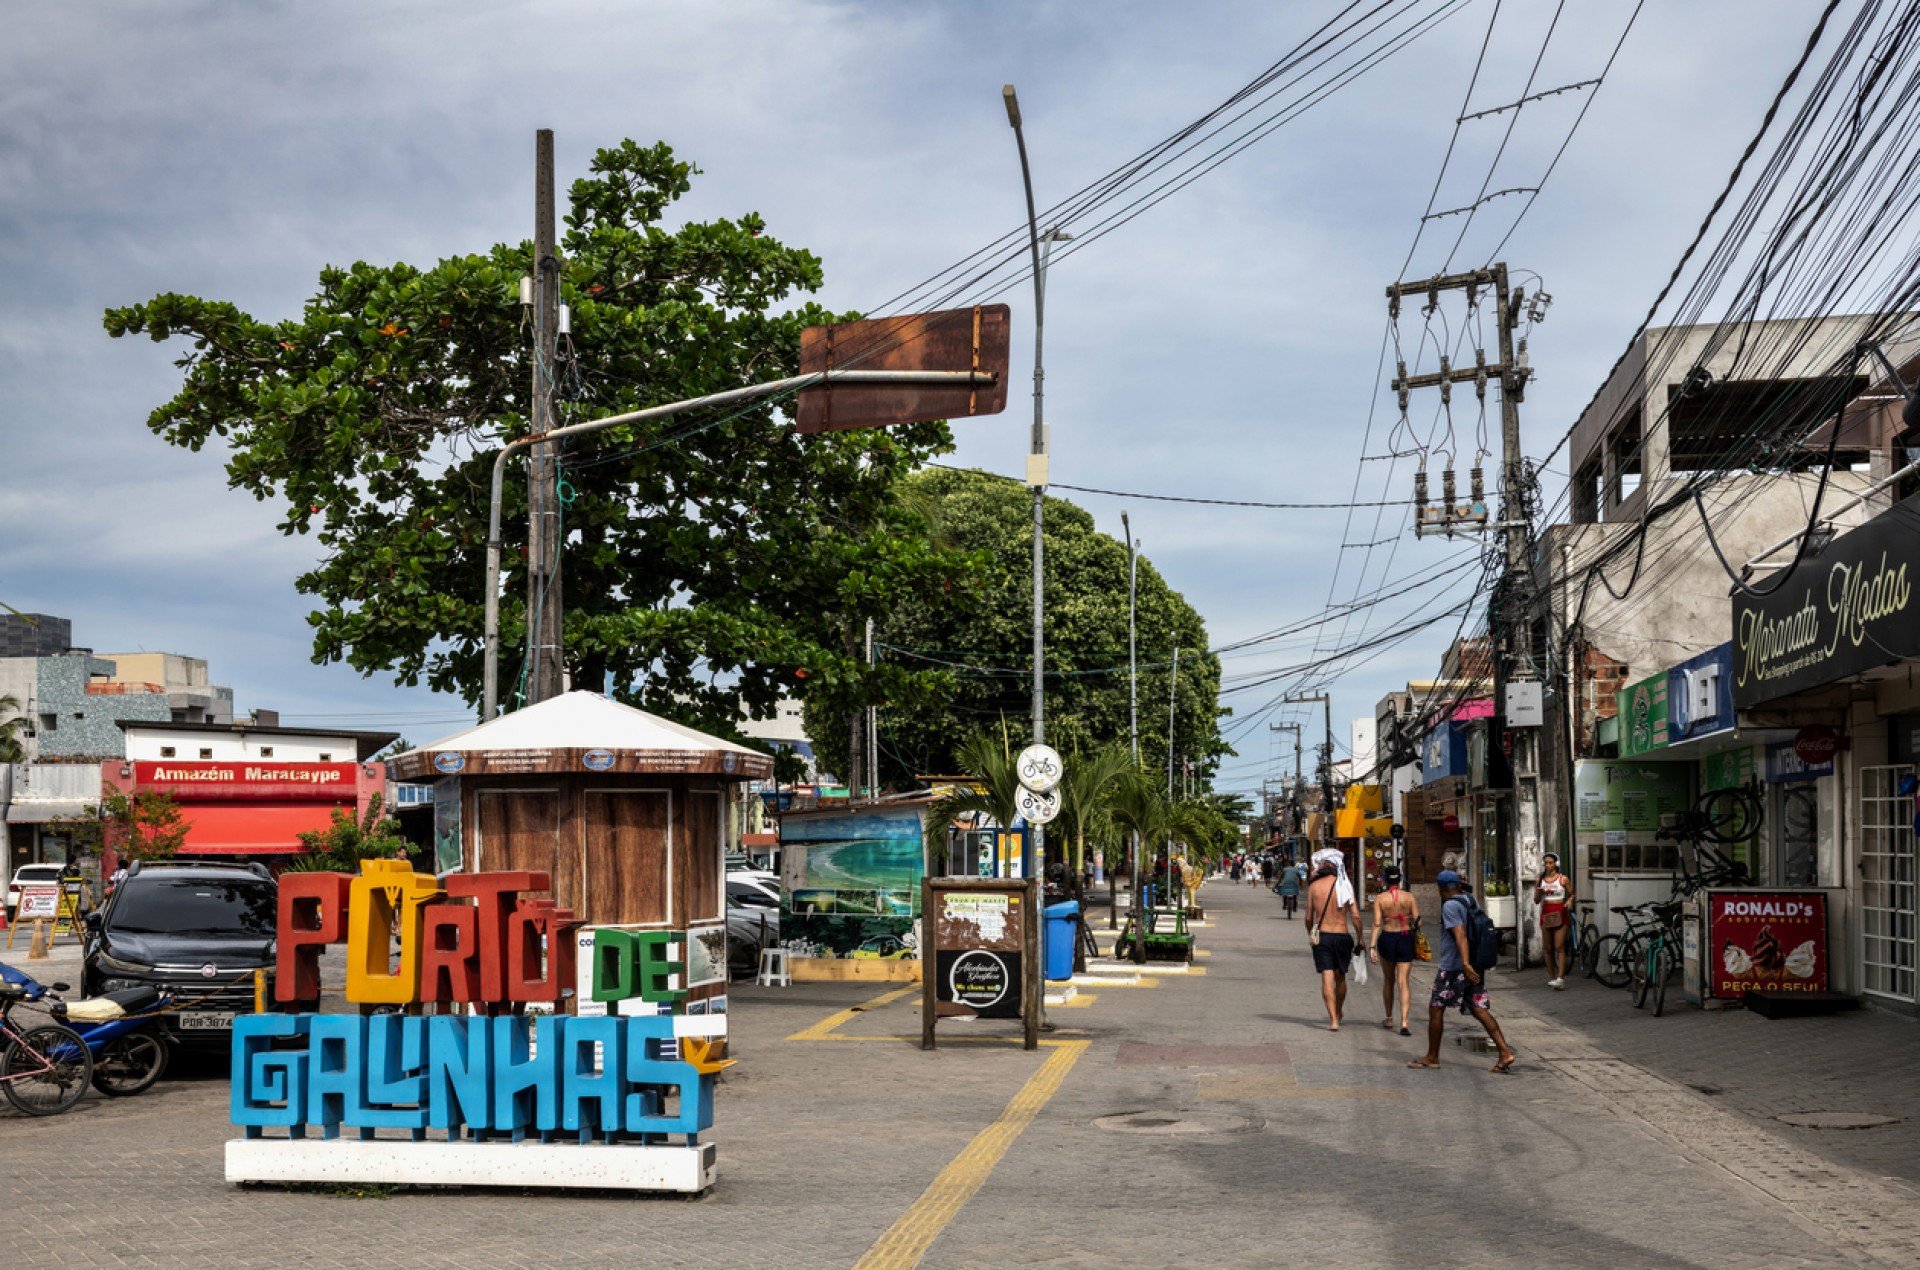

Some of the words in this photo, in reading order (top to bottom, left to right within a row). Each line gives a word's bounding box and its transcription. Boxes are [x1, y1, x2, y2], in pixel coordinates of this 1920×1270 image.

[1824, 550, 1912, 658] Modas
[153, 766, 235, 781] Armazém
[245, 766, 341, 784] Maracaype
[276, 859, 587, 1003] PORTO
[592, 929, 688, 1003] DE
[1724, 901, 1814, 917] RONALD's
[230, 1013, 715, 1134] GALINHAS
